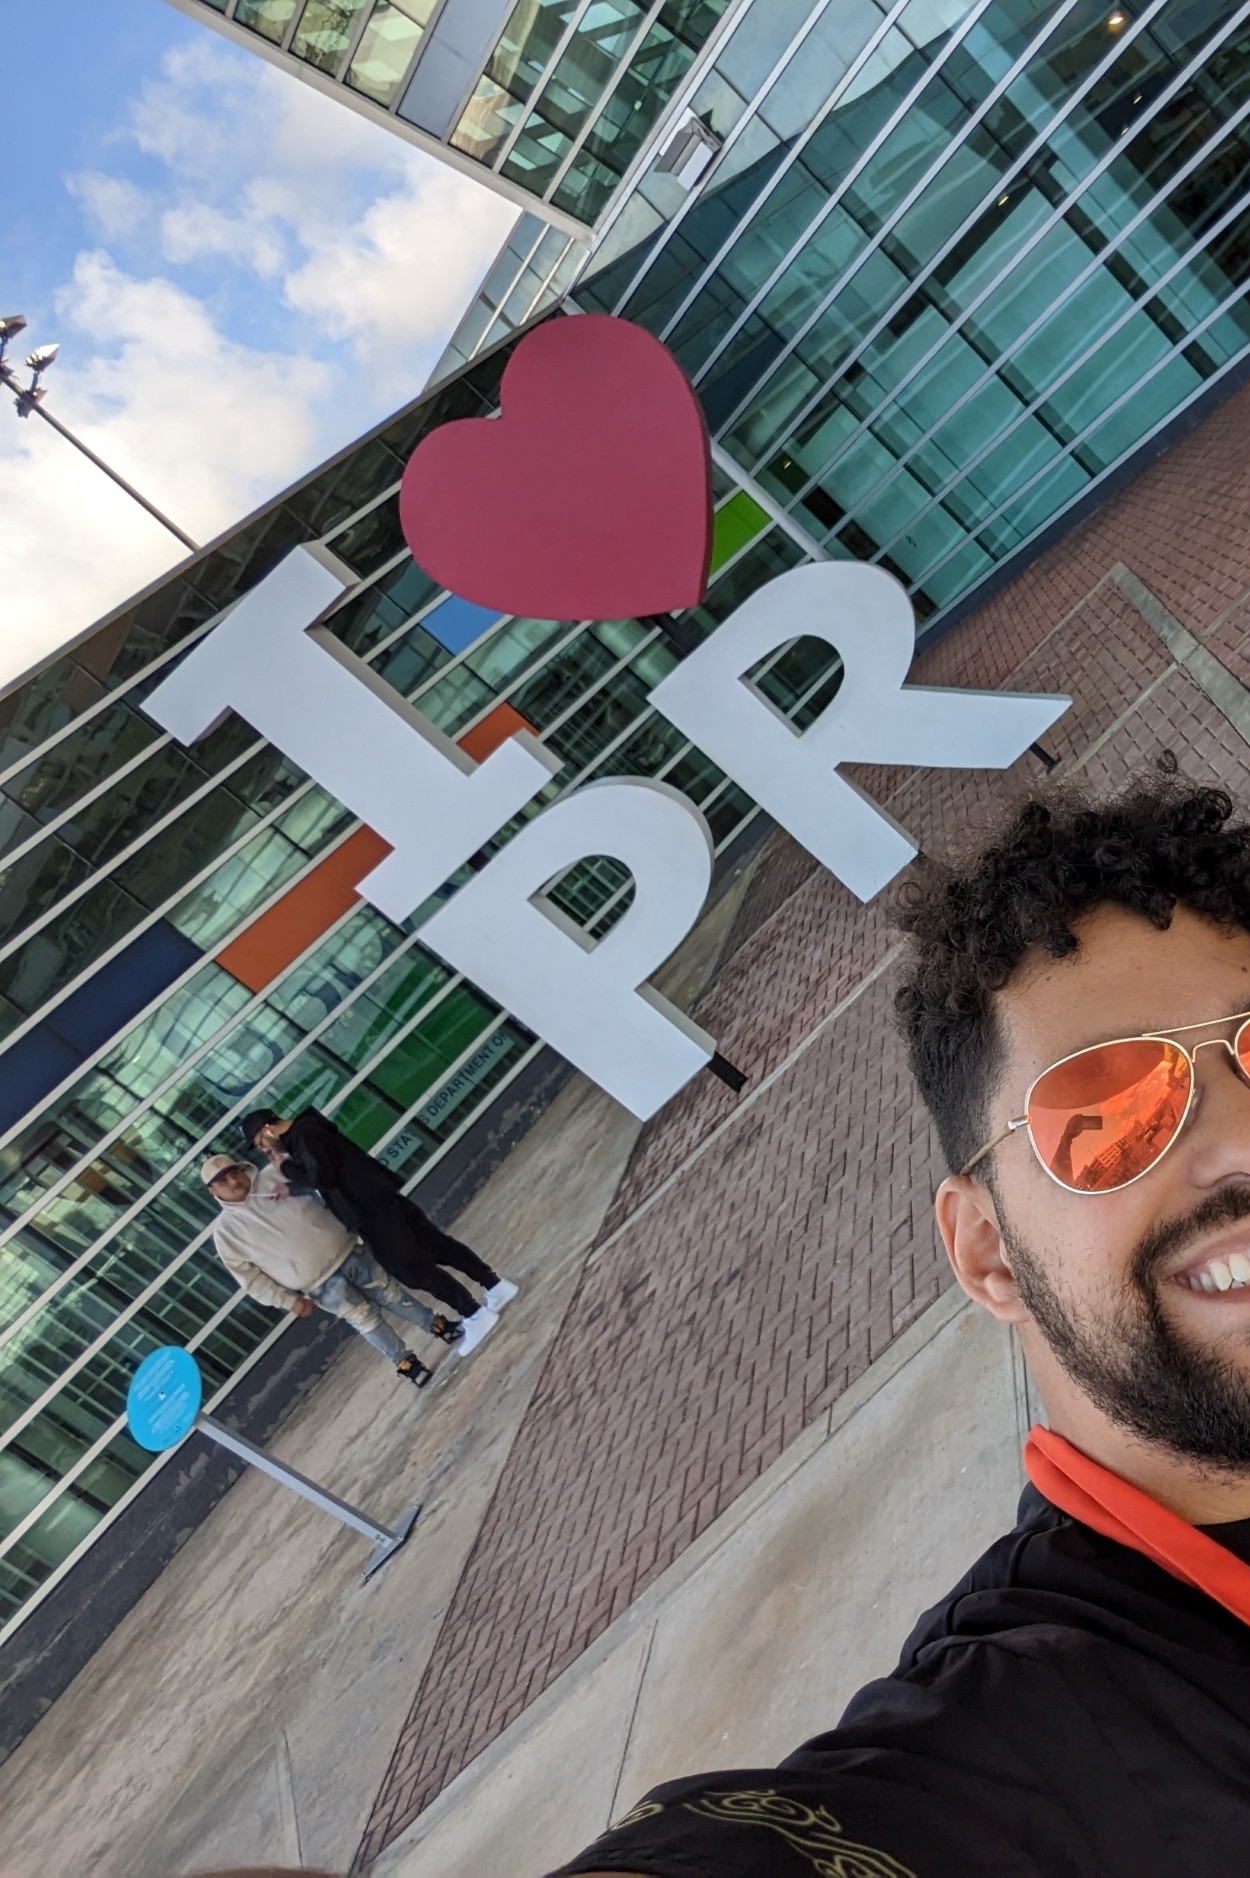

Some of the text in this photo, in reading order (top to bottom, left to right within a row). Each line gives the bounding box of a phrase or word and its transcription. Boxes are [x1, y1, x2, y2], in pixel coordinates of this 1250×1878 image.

[139, 543, 562, 934] I
[387, 1114, 430, 1159] STAS
[427, 1046, 496, 1116] DEPARTMENT
